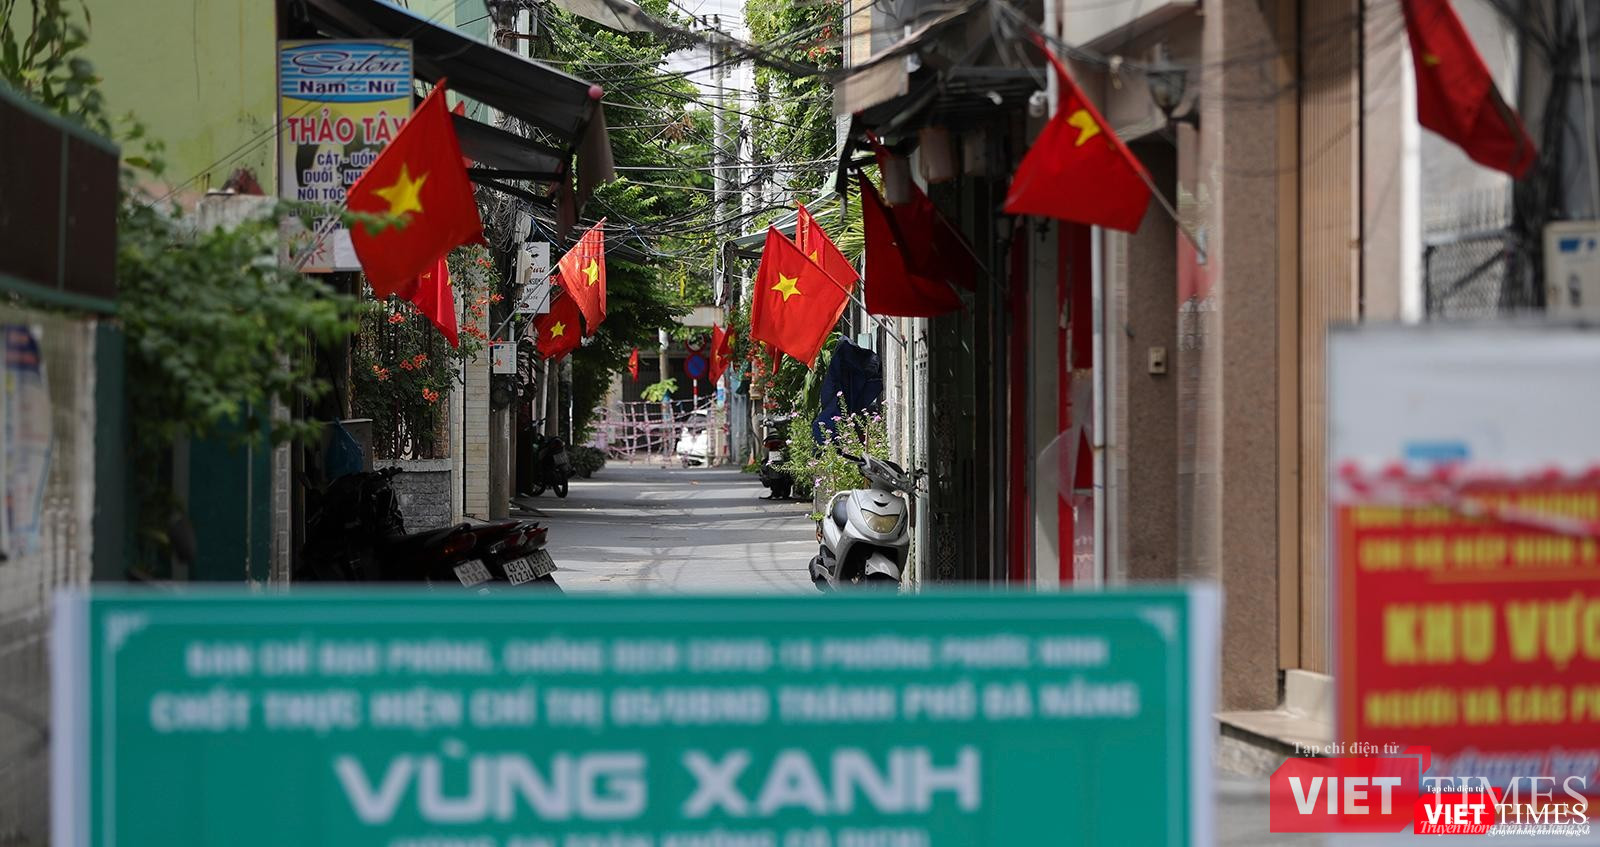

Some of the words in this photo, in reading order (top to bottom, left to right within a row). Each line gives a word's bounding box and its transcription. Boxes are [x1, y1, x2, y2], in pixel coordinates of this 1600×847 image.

[292, 51, 401, 75] Salon
[300, 81, 346, 93] Nam
[367, 80, 396, 93] Nữ
[286, 108, 355, 143] THẢO
[1384, 602, 1494, 665] KHU
[150, 684, 249, 733] CHỐT
[263, 688, 363, 735] THỰC
[370, 685, 463, 733] HIỆN
[777, 684, 897, 724] THÀNH
[902, 676, 977, 722] PHỐ
[333, 738, 649, 825] VÙNG
[680, 747, 982, 817] XANH
